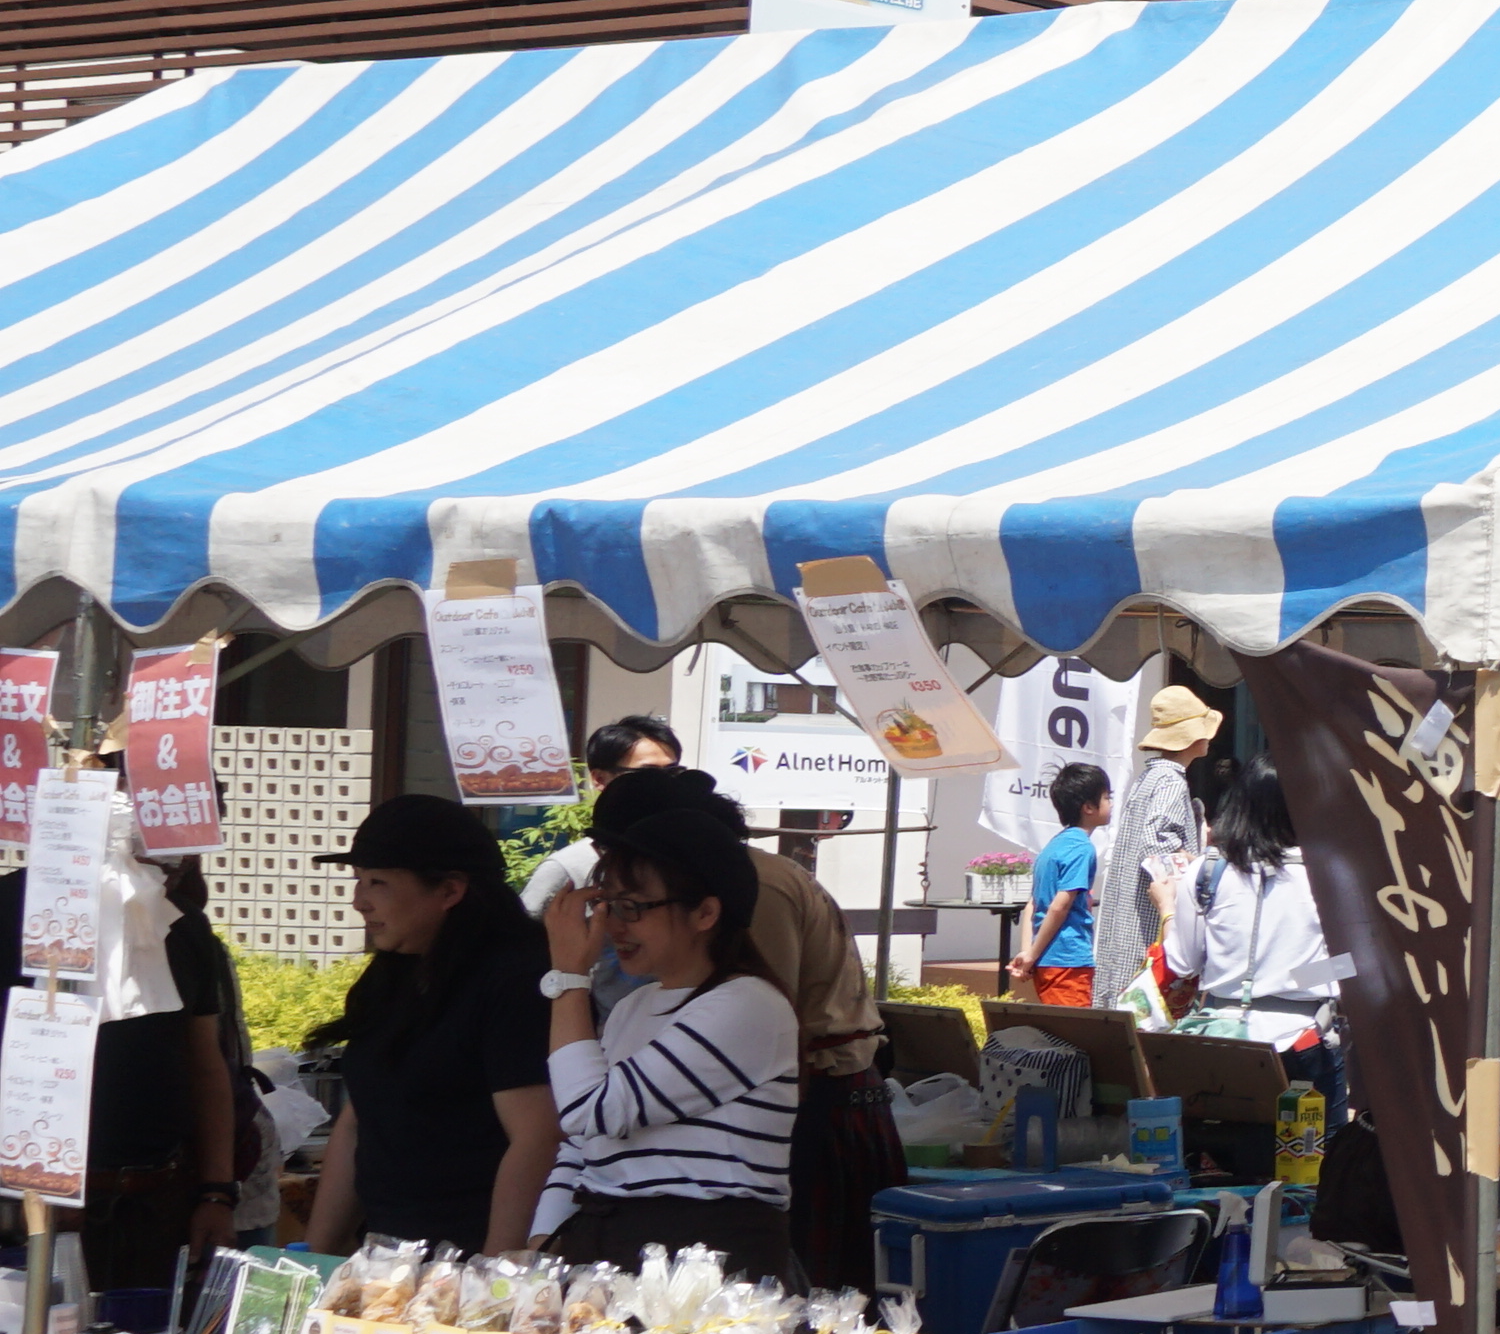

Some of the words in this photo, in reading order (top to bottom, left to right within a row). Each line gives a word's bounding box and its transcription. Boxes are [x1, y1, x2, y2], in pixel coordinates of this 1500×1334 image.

[507, 664, 535, 676] ¥250
[910, 679, 942, 693] ¥350
[130, 675, 211, 723] 御注文
[157, 733, 178, 770] &
[135, 782, 212, 827] お会計
